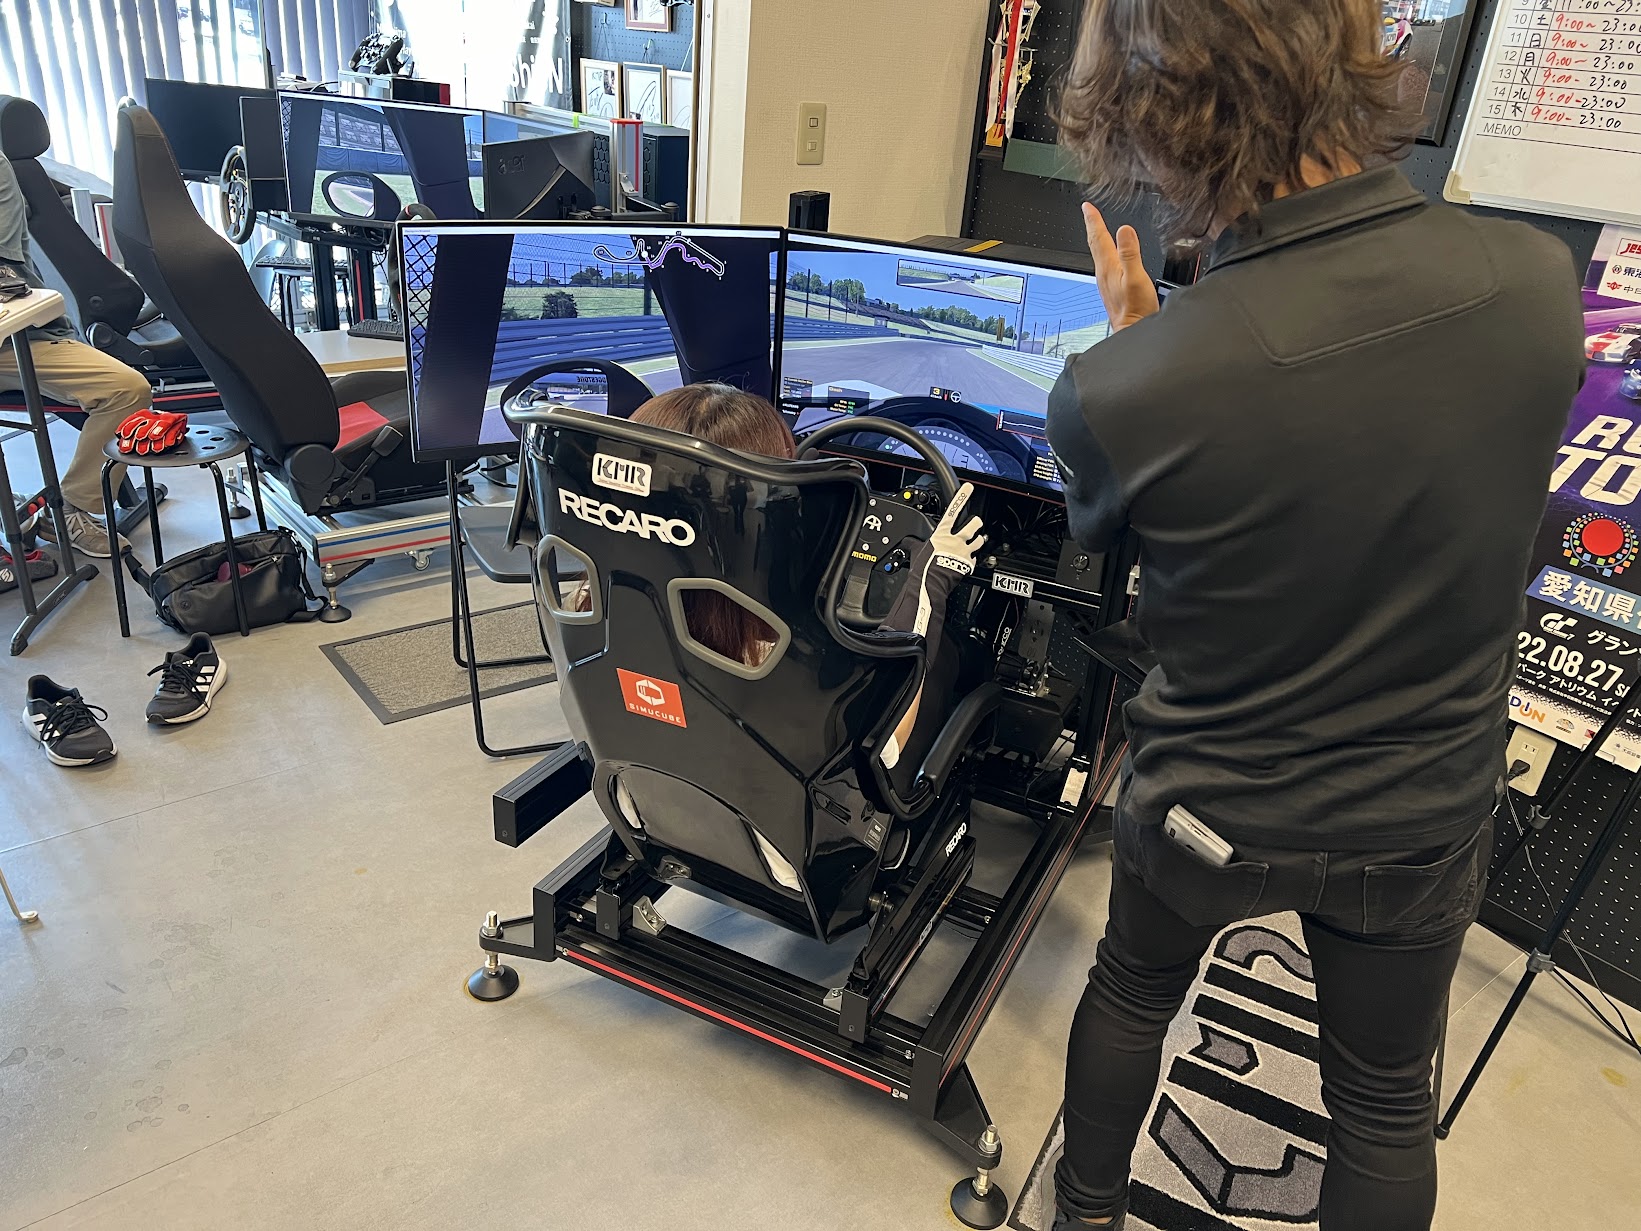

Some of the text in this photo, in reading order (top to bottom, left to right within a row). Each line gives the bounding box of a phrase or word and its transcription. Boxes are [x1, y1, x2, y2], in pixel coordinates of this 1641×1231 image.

[1514, 14, 1528, 25] 10
[1537, 13, 1550, 26] 土
[1510, 32, 1522, 43] 11
[1530, 32, 1542, 48] 日
[1504, 50, 1518, 61] 12
[1499, 68, 1512, 79] 13
[1494, 86, 1506, 97] 14
[1489, 104, 1502, 115] 15
[1483, 122, 1522, 137] MEMO
[557, 487, 697, 547] RECARO
[1539, 570, 1641, 631] 愛知県
[1587, 629, 1641, 656] グラン
[1549, 674, 1597, 702] アトリウム
[628, 702, 682, 724] SIMUCUBE
[945, 821, 967, 857] RECARO
